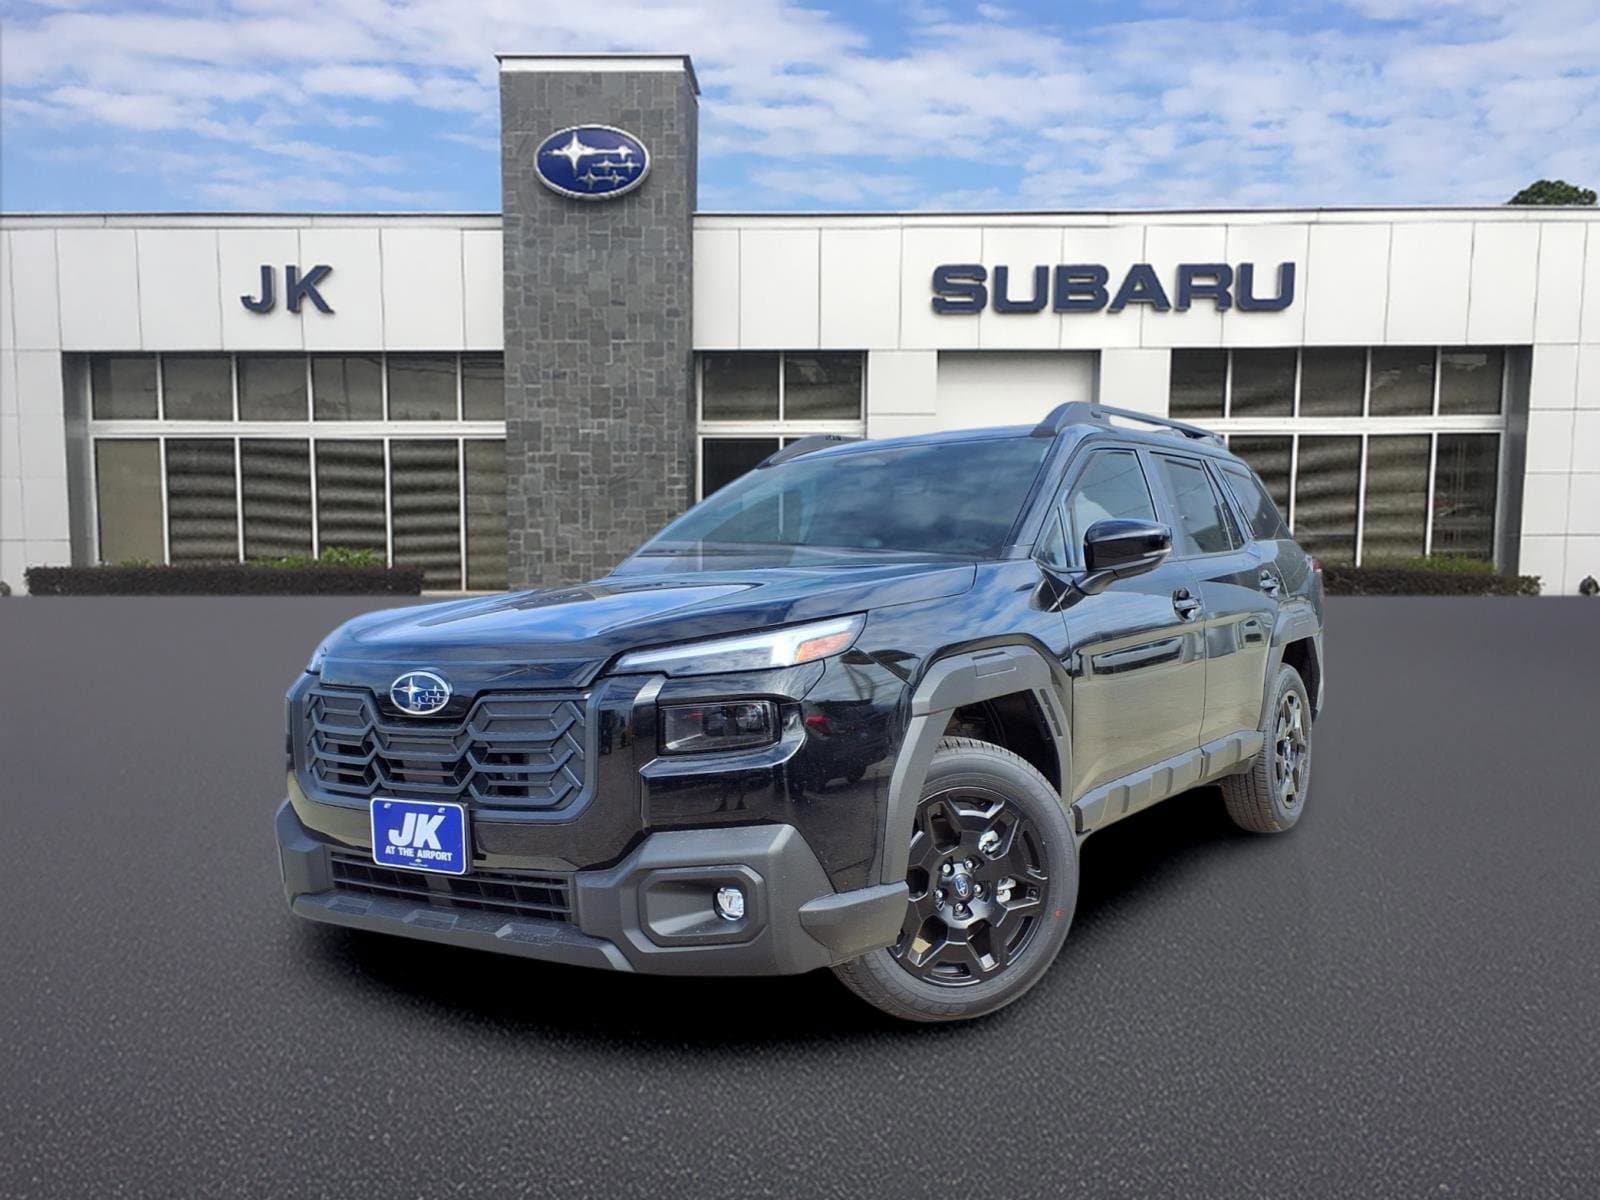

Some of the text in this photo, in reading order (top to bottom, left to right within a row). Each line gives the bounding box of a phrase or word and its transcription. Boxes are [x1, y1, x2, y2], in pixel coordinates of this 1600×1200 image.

[240, 265, 335, 314] JK
[931, 262, 1296, 315] SUBARU
[388, 812, 446, 850] JK
[385, 845, 453, 861] AT THE AIRPORT
